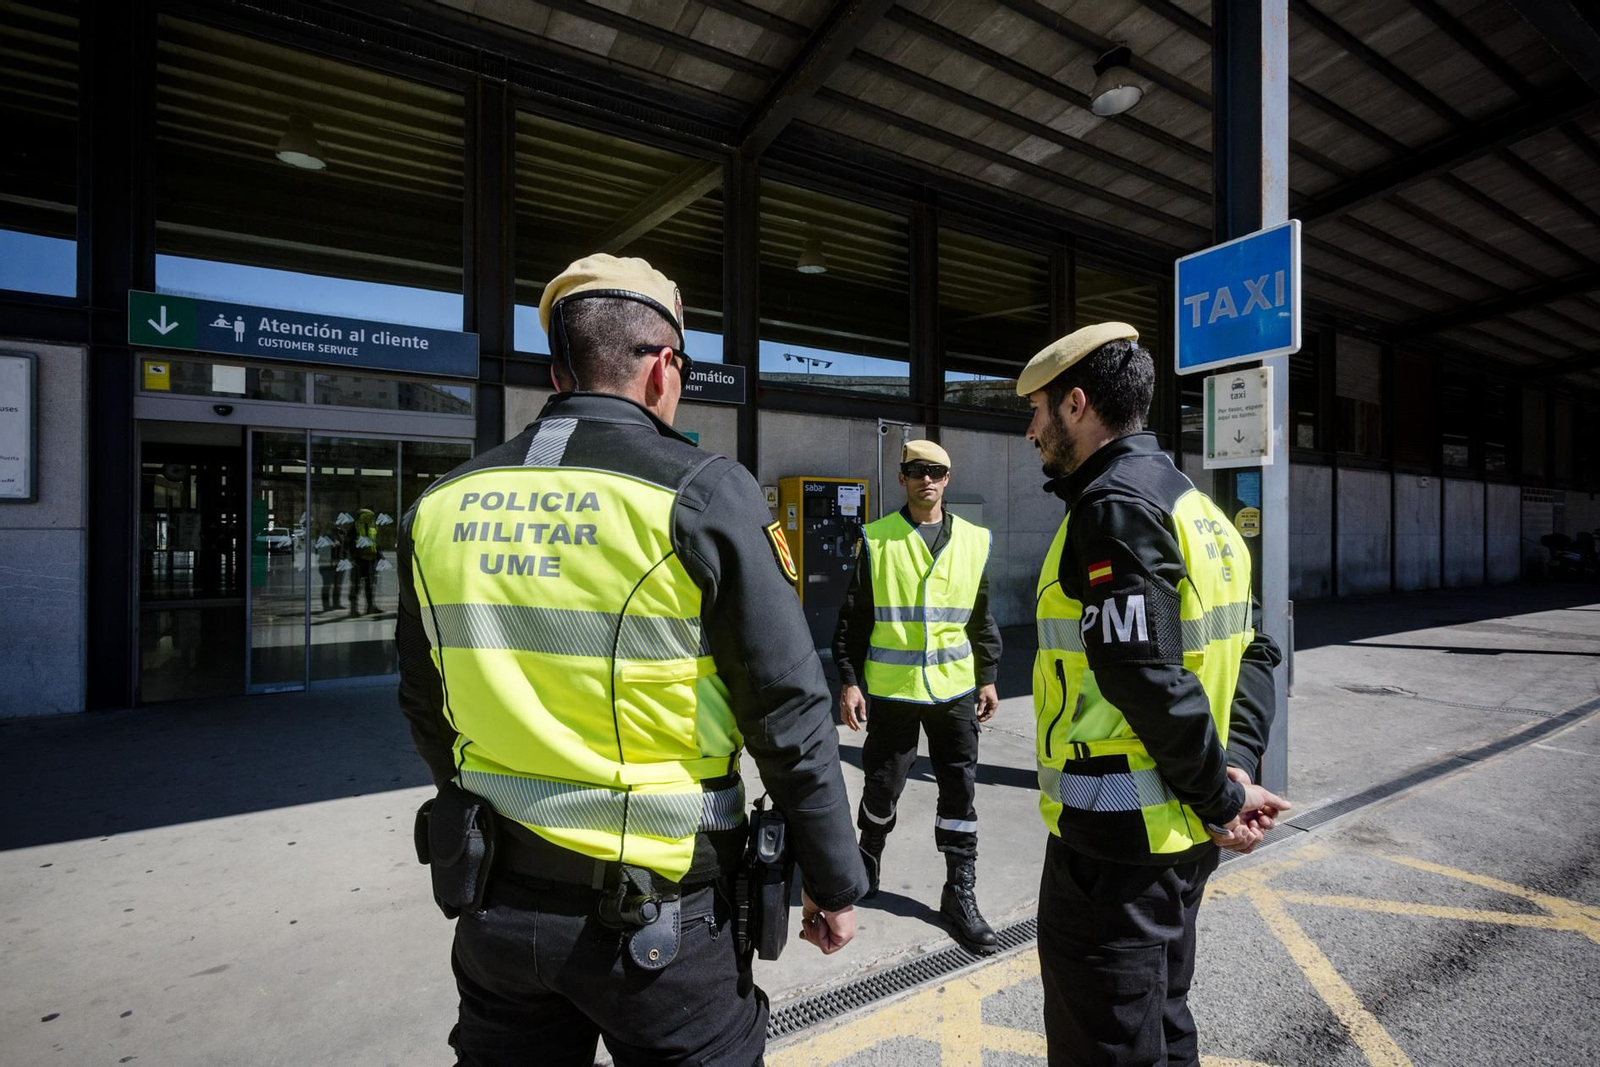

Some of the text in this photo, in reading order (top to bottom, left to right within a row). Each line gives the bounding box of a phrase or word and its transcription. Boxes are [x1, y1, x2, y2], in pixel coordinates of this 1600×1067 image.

[1183, 270, 1285, 328] TAXI
[258, 317, 429, 349] Atención al cliente
[258, 337, 358, 356] CUSTOMER SERVICE
[689, 370, 735, 385] omático
[1230, 390, 1246, 399] taxi
[804, 483, 824, 492] saba
[459, 491, 600, 513] POLICIA
[452, 521, 598, 545] MILITAR
[479, 553, 561, 578] UME
[1080, 594, 1149, 647] PM
